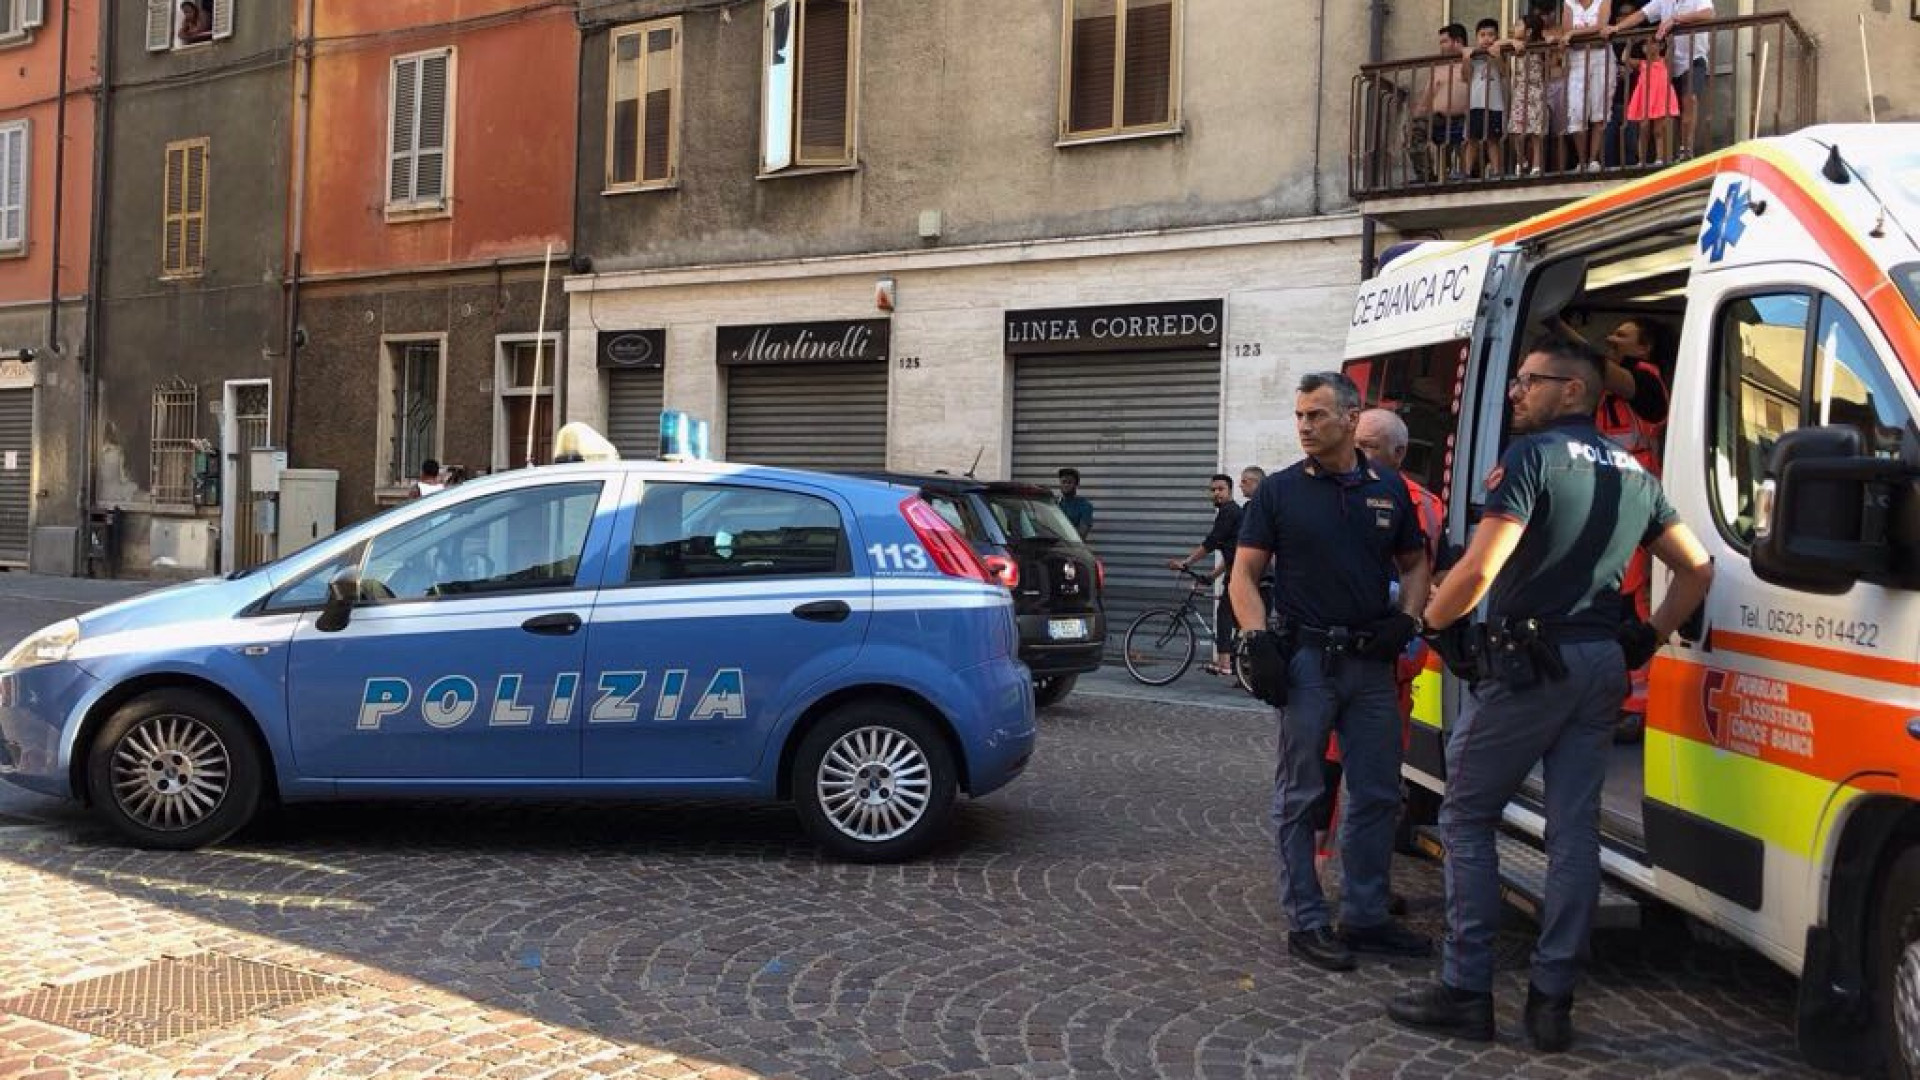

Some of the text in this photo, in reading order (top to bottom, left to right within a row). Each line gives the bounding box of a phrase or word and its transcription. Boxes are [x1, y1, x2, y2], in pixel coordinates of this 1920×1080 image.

[1374, 274, 1437, 321] BIANCA
[1438, 264, 1469, 306] PC
[1008, 313, 1217, 342] LINEA CORREDO
[732, 325, 872, 360] Martinelli
[1235, 343, 1261, 357] 123
[899, 357, 920, 369] 125
[868, 543, 927, 569] 113
[1740, 605, 1762, 629] Tel.
[356, 668, 747, 729] POLIZIA
